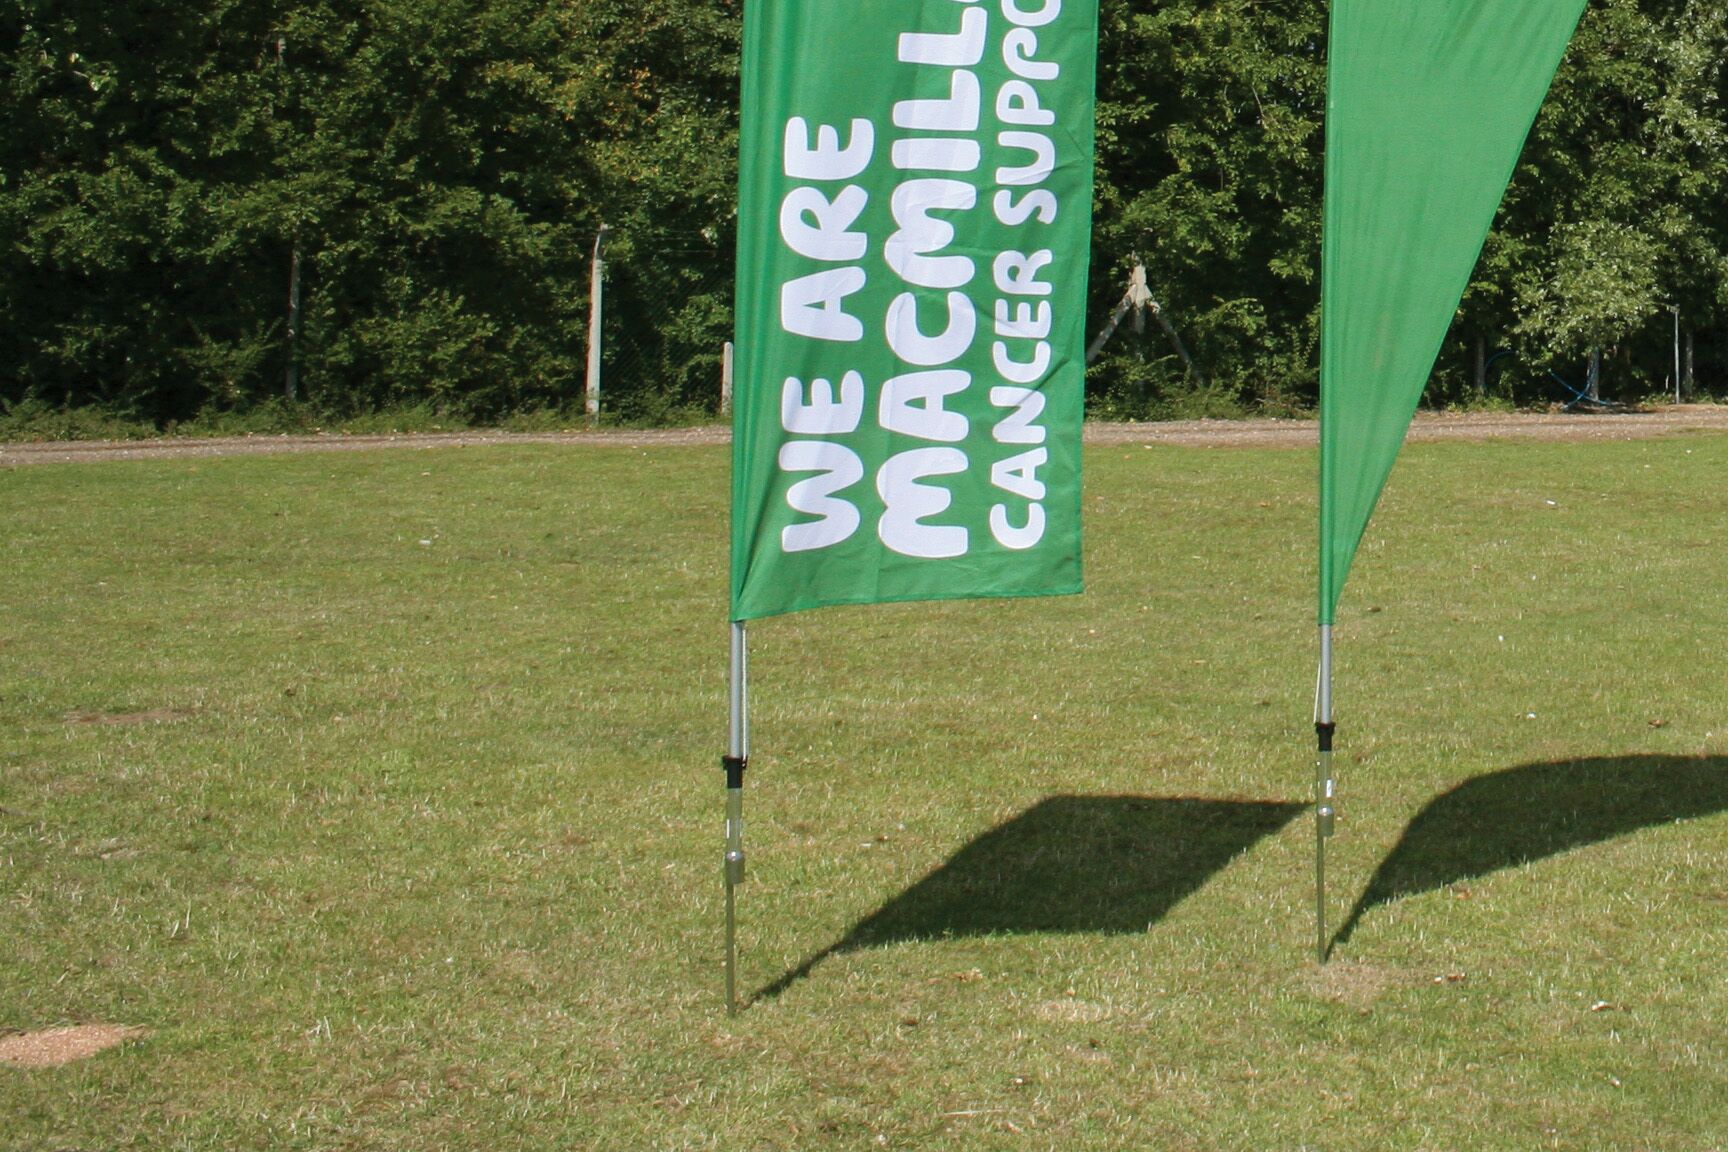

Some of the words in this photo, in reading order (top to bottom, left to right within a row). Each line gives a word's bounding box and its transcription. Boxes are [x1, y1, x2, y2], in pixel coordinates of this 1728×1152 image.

[779, 116, 874, 341] ARE
[779, 370, 864, 552] WE
[988, 249, 1053, 550] CANCER
